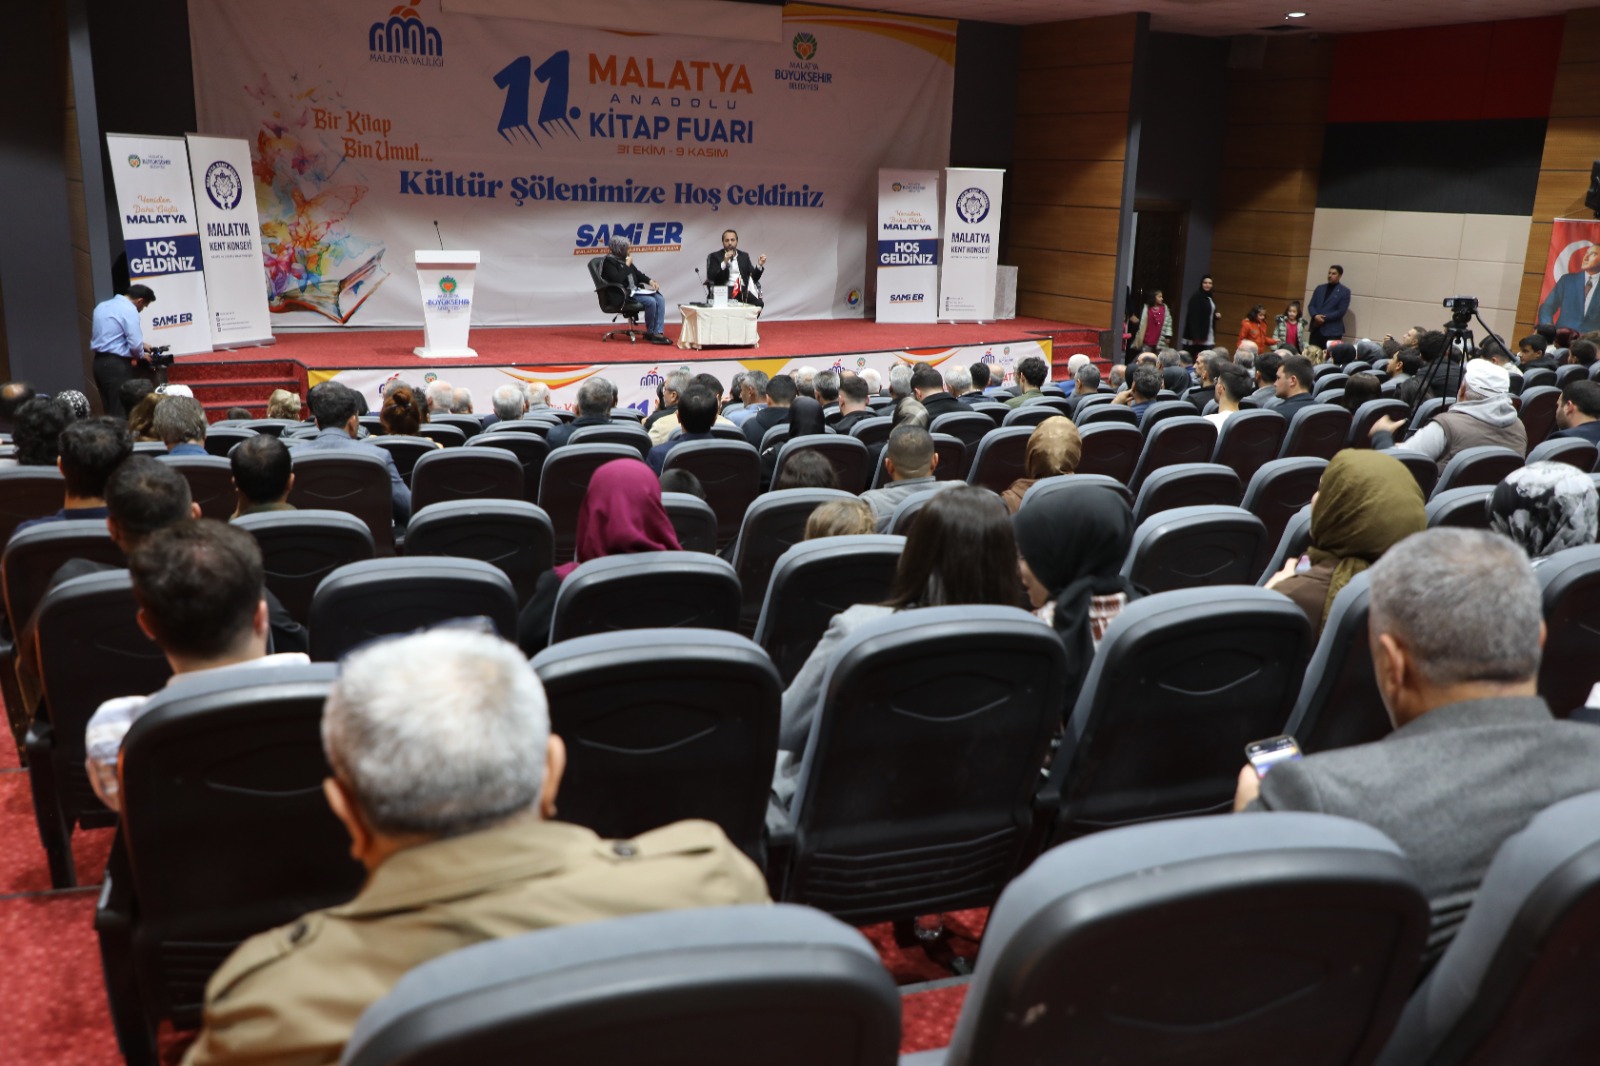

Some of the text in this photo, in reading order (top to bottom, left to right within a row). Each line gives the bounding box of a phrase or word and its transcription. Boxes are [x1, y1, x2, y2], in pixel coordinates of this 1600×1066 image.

[369, 53, 408, 65] MALATYA
[790, 62, 818, 70] MALATYA
[588, 53, 753, 94] MALATYA
[775, 69, 832, 84] BÜYÜKŞEHİR
[610, 93, 737, 110] ANADOLU
[311, 107, 392, 137] Bir Kitap
[590, 108, 753, 144] KİTAP FUARI
[341, 136, 372, 158] Bin
[617, 144, 629, 155] 31
[632, 144, 666, 156] EKİM
[676, 147, 685, 157] 9
[687, 147, 728, 158] KASIM
[399, 169, 824, 211] Kültür Şölenimize Hoş Geldiniz
[138, 194, 172, 204] Yeniden
[126, 214, 187, 224] MALATYA
[207, 222, 250, 237] MALATYA
[647, 222, 684, 244] ER
[884, 223, 932, 231] MALATYA
[952, 232, 990, 244] MALATYA
[146, 241, 177, 256] HOŞ
[209, 242, 226, 251] KENT
[894, 242, 920, 254] HOŞ
[180, 312, 192, 324] ER
